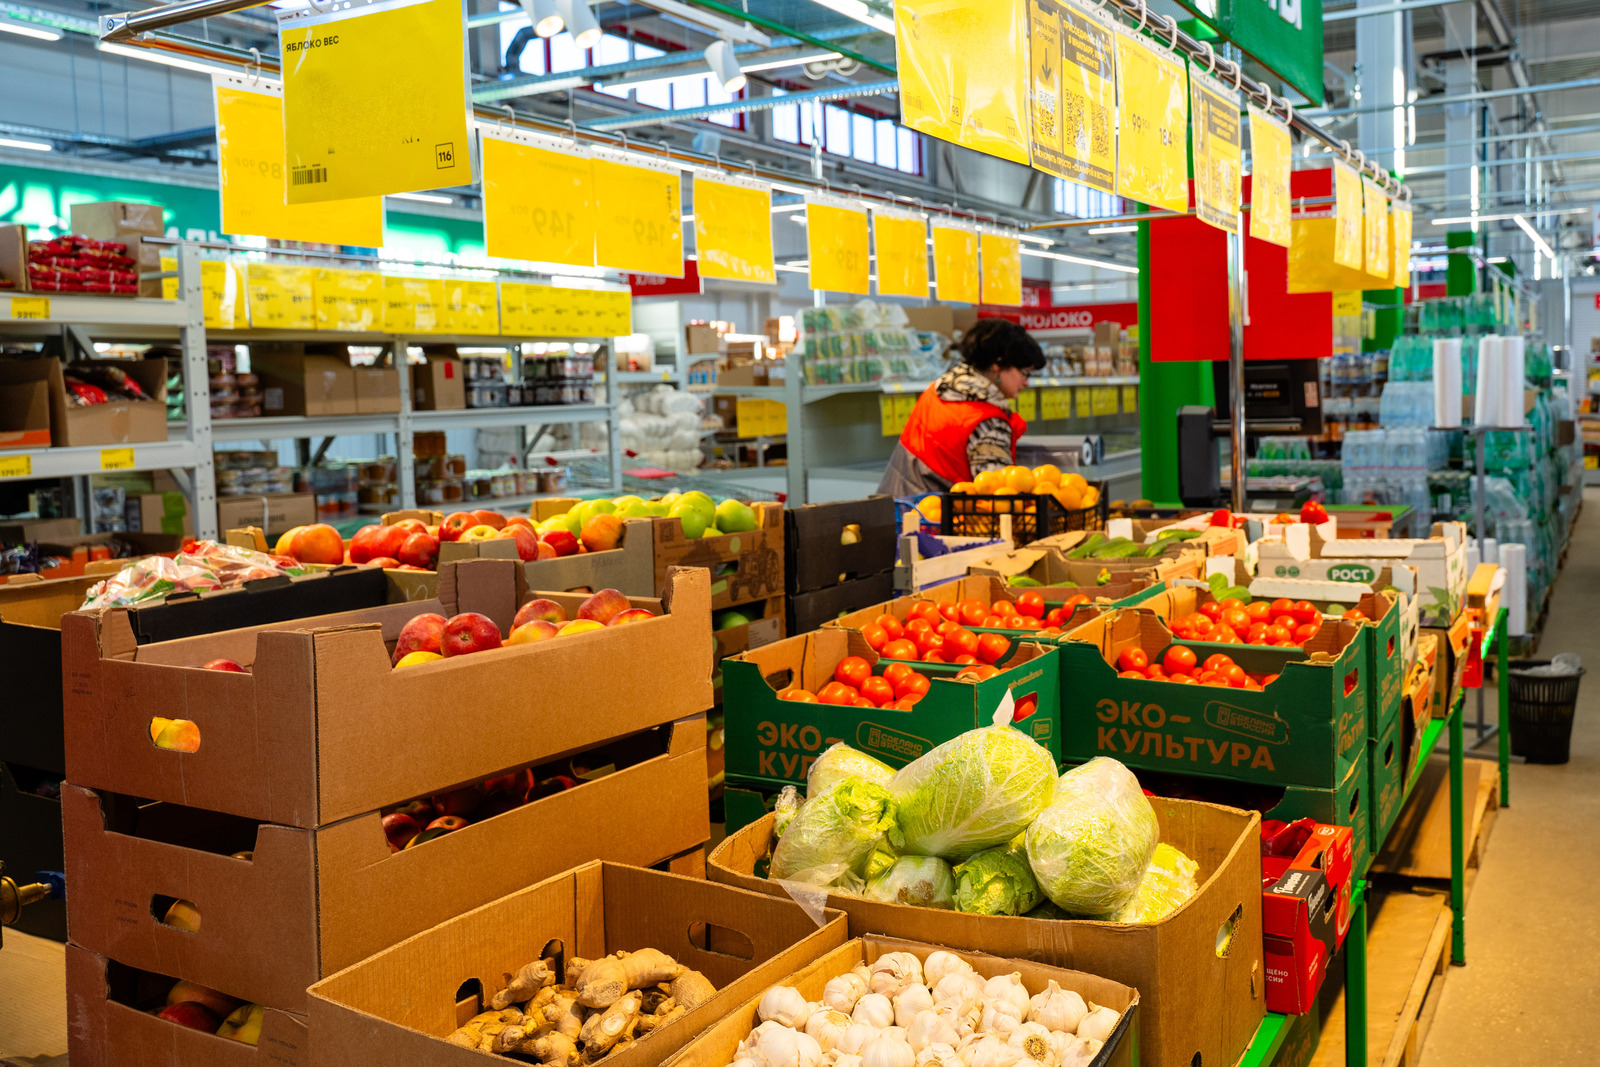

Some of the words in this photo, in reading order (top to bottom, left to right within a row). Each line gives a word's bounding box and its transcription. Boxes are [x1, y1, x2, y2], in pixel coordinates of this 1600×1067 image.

[286, 38, 322, 52] ЯБЛОКО
[323, 35, 339, 47] ВЕС
[1132, 113, 1142, 134] 99
[438, 150, 452, 162] 116
[1019, 311, 1093, 329] МОЛОКО
[1331, 568, 1370, 581] РОСТ
[1230, 712, 1277, 729] СДЕЛАНО
[1236, 720, 1276, 737] РОССИИ
[881, 734, 923, 752] СДЕЛАНО
[886, 742, 923, 758] РОССИИ
[1097, 726, 1276, 772] КУЛЬТУРА
[1266, 967, 1289, 977] ЩЕНО
